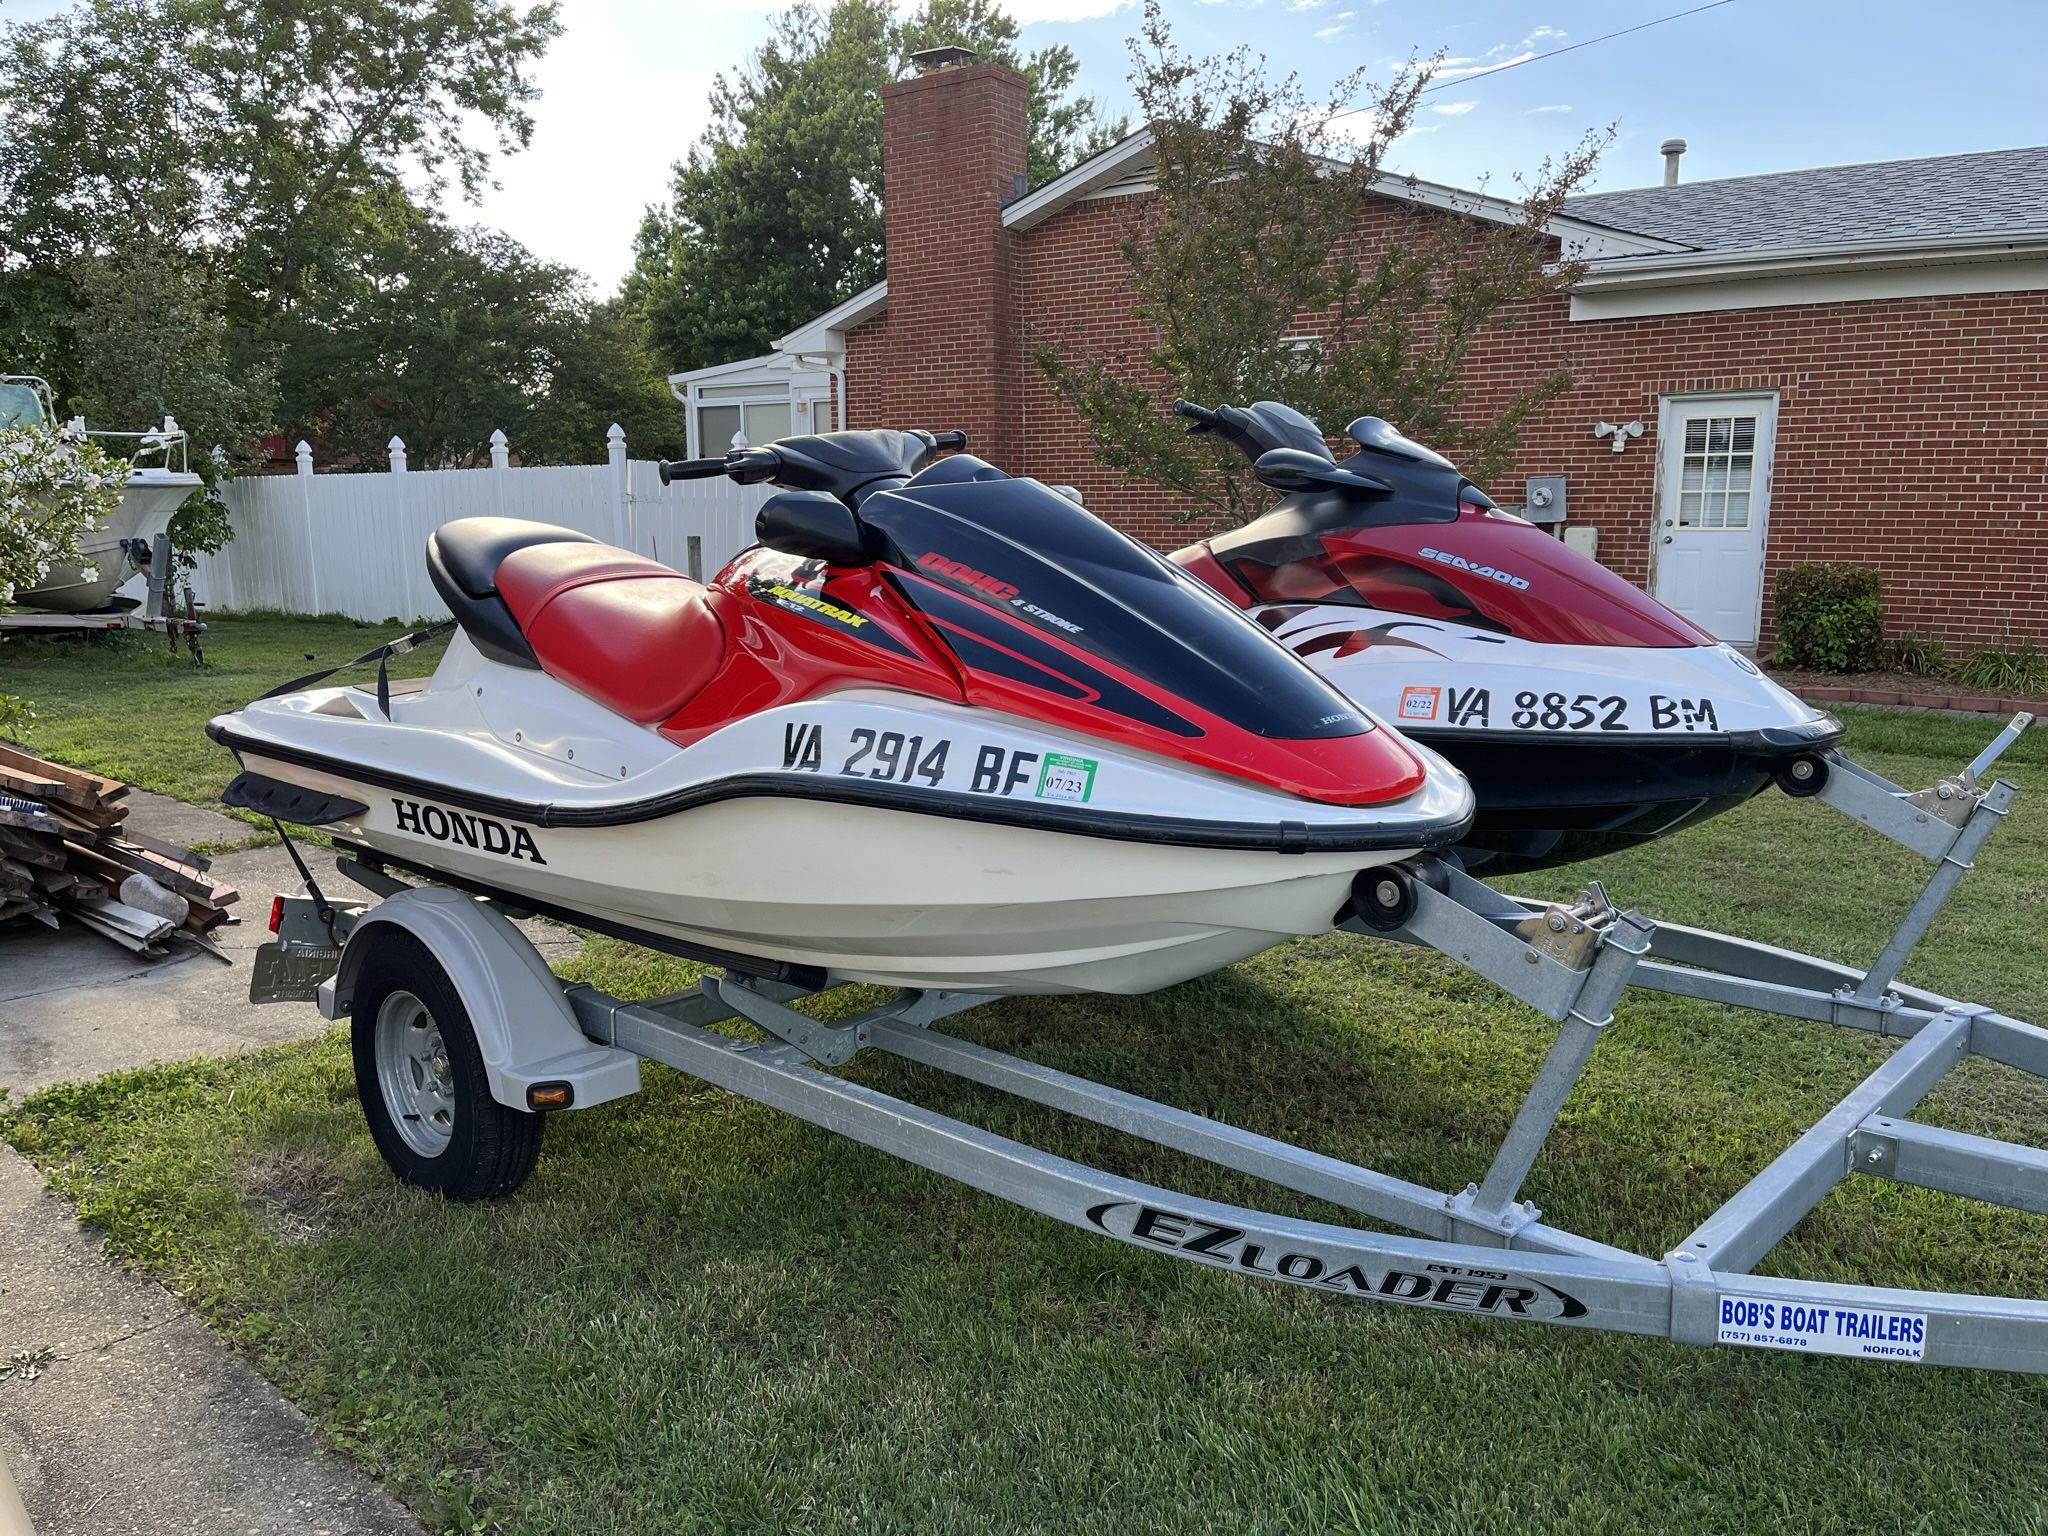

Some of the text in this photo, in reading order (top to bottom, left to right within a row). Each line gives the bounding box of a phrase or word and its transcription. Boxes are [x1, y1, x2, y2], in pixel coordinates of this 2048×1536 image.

[916, 551, 1021, 599] DOHC
[767, 586, 869, 628] AQUATRAX
[1010, 599, 1084, 634] 4 STROKE
[1406, 700, 1432, 709] 02/22
[1448, 687, 1719, 731] VA 8852 BM
[782, 722, 823, 772] VA
[839, 728, 952, 787] 2914
[968, 744, 1039, 796] BF
[1046, 776, 1082, 793] 07/23
[391, 798, 548, 865] HONDA
[1426, 1263, 1509, 1281] EST. 1953
[1720, 1330, 1807, 1347] (757) 857-6878
[1721, 1300, 1924, 1343] BOB'S BOAT TRAILERS
[1863, 1345, 1921, 1358] NORFOLK
